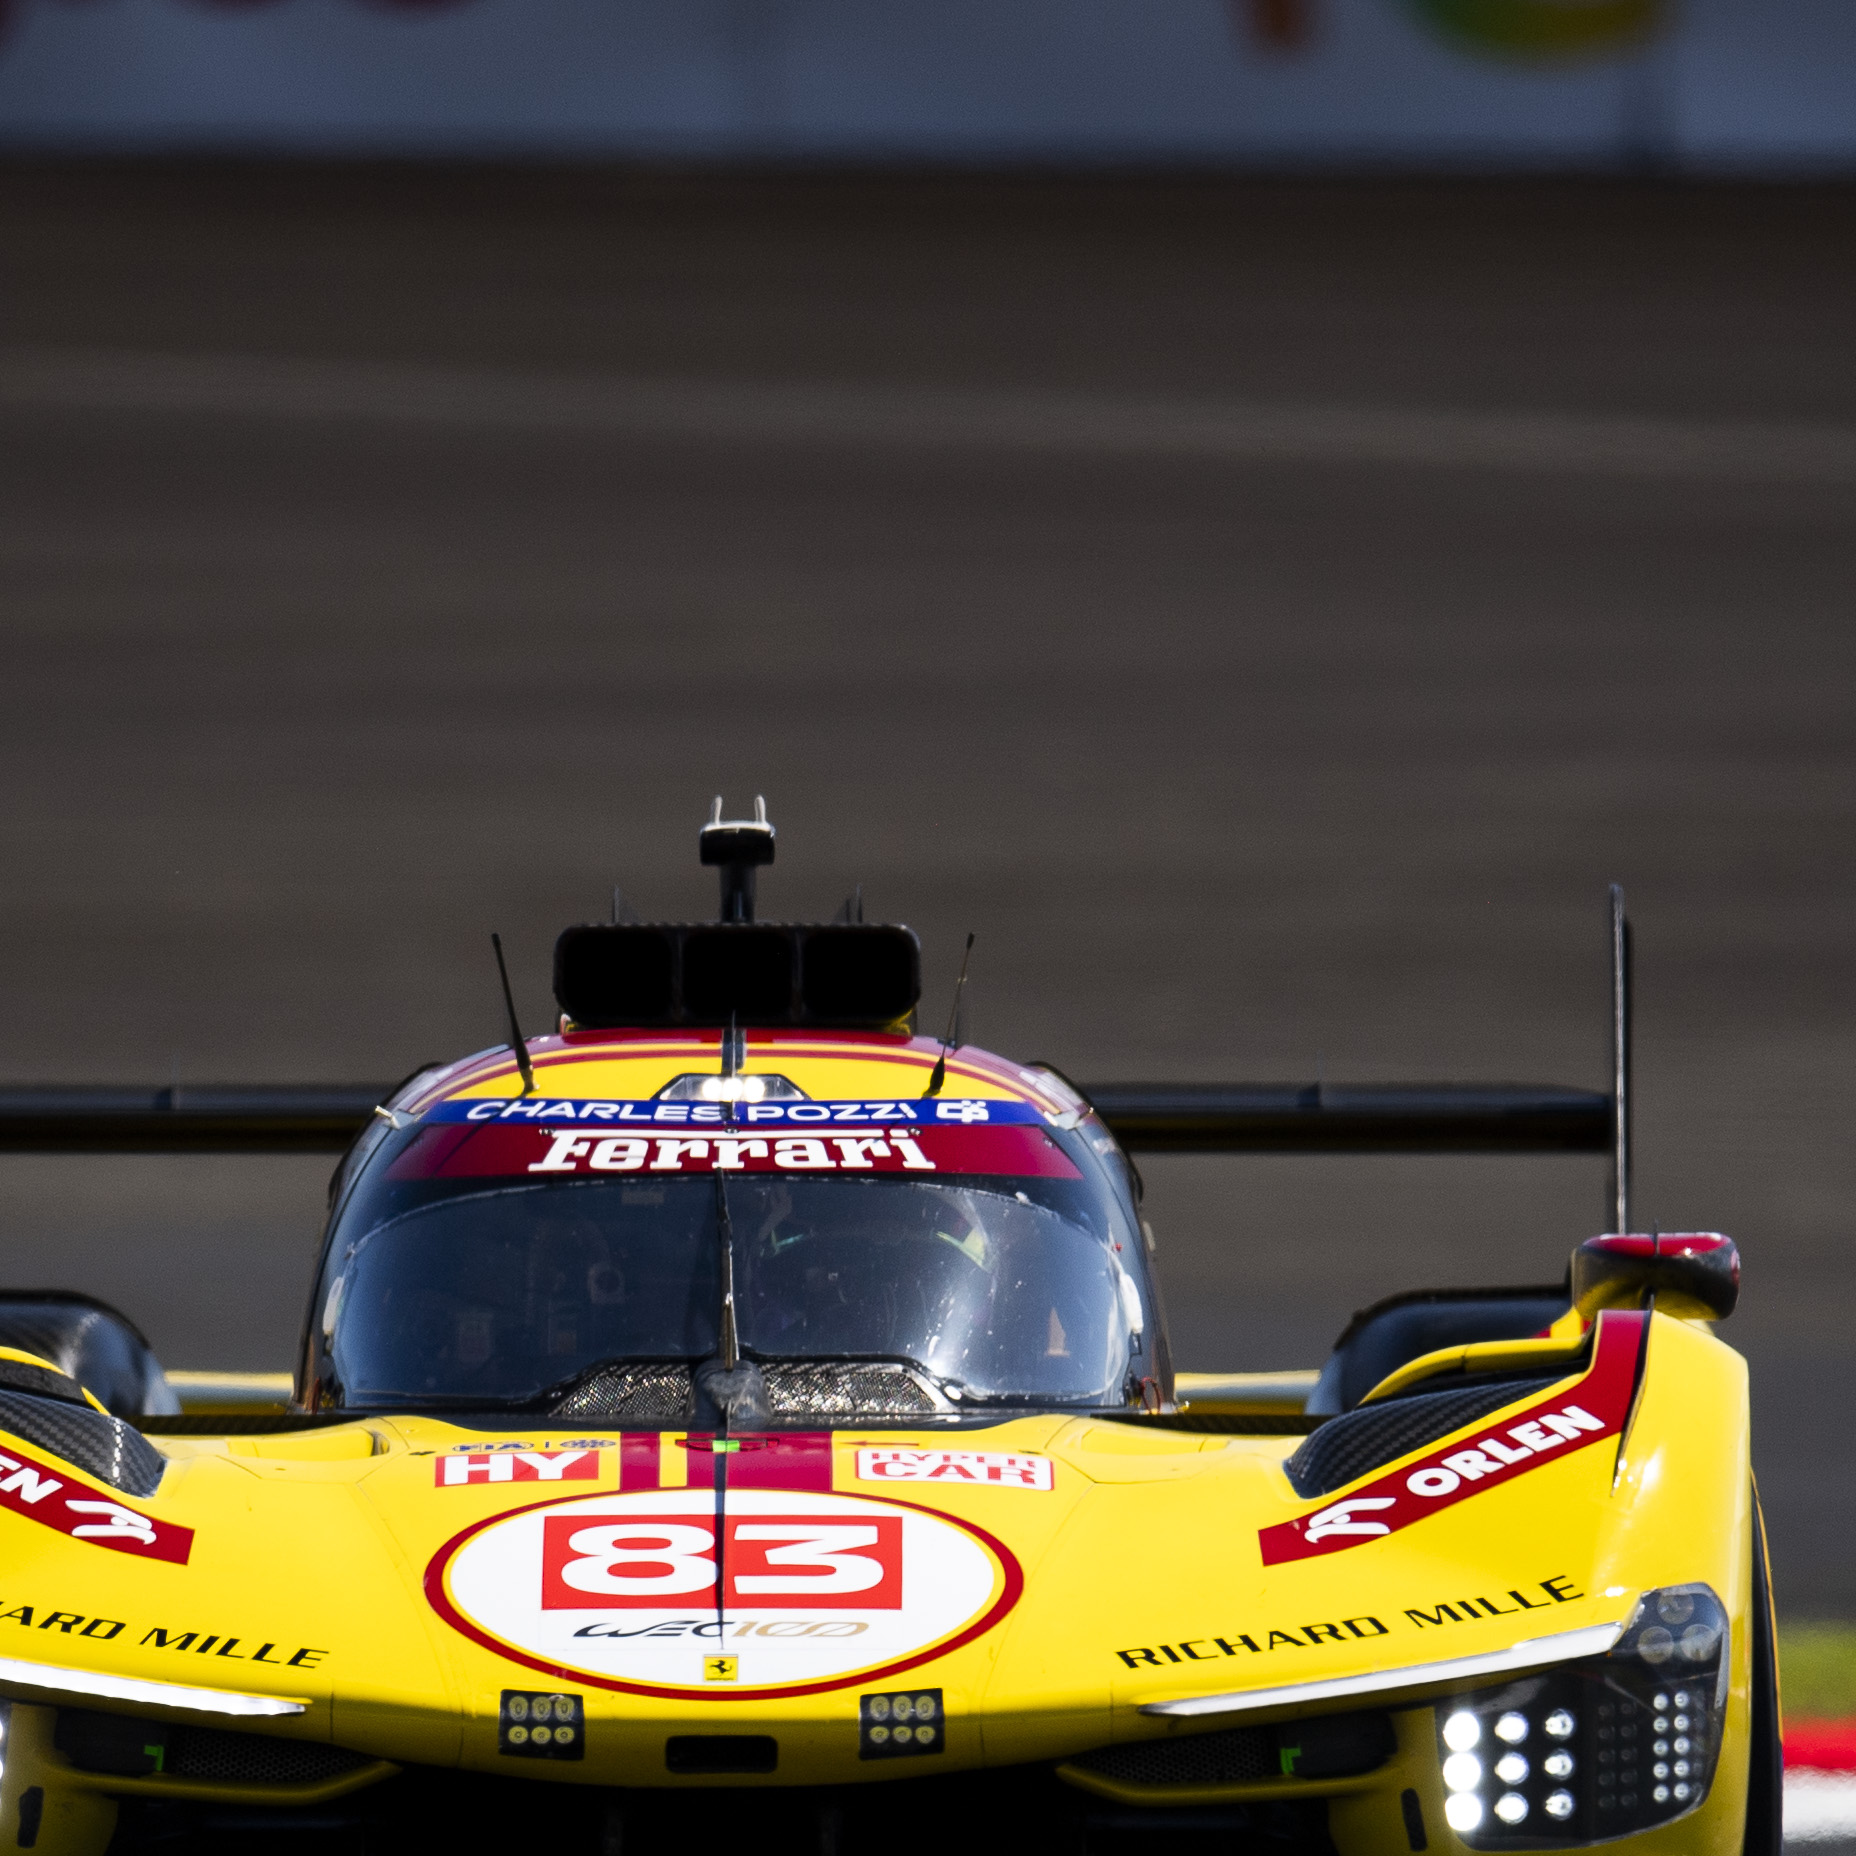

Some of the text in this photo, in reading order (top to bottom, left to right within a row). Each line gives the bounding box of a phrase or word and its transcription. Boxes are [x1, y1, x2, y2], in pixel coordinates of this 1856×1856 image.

[466, 1101, 725, 1122] CHARLES
[748, 1103, 918, 1122] POZZI
[528, 1128, 936, 1173] Ferrari
[443, 1450, 590, 1486] HY
[871, 1461, 1037, 1485] CAR
[1406, 1405, 1606, 1498] ORLEN
[561, 1523, 884, 1597] 83
[1114, 1574, 1586, 1669] RICHARD MILLE
[139, 1626, 330, 1669] MILLE
